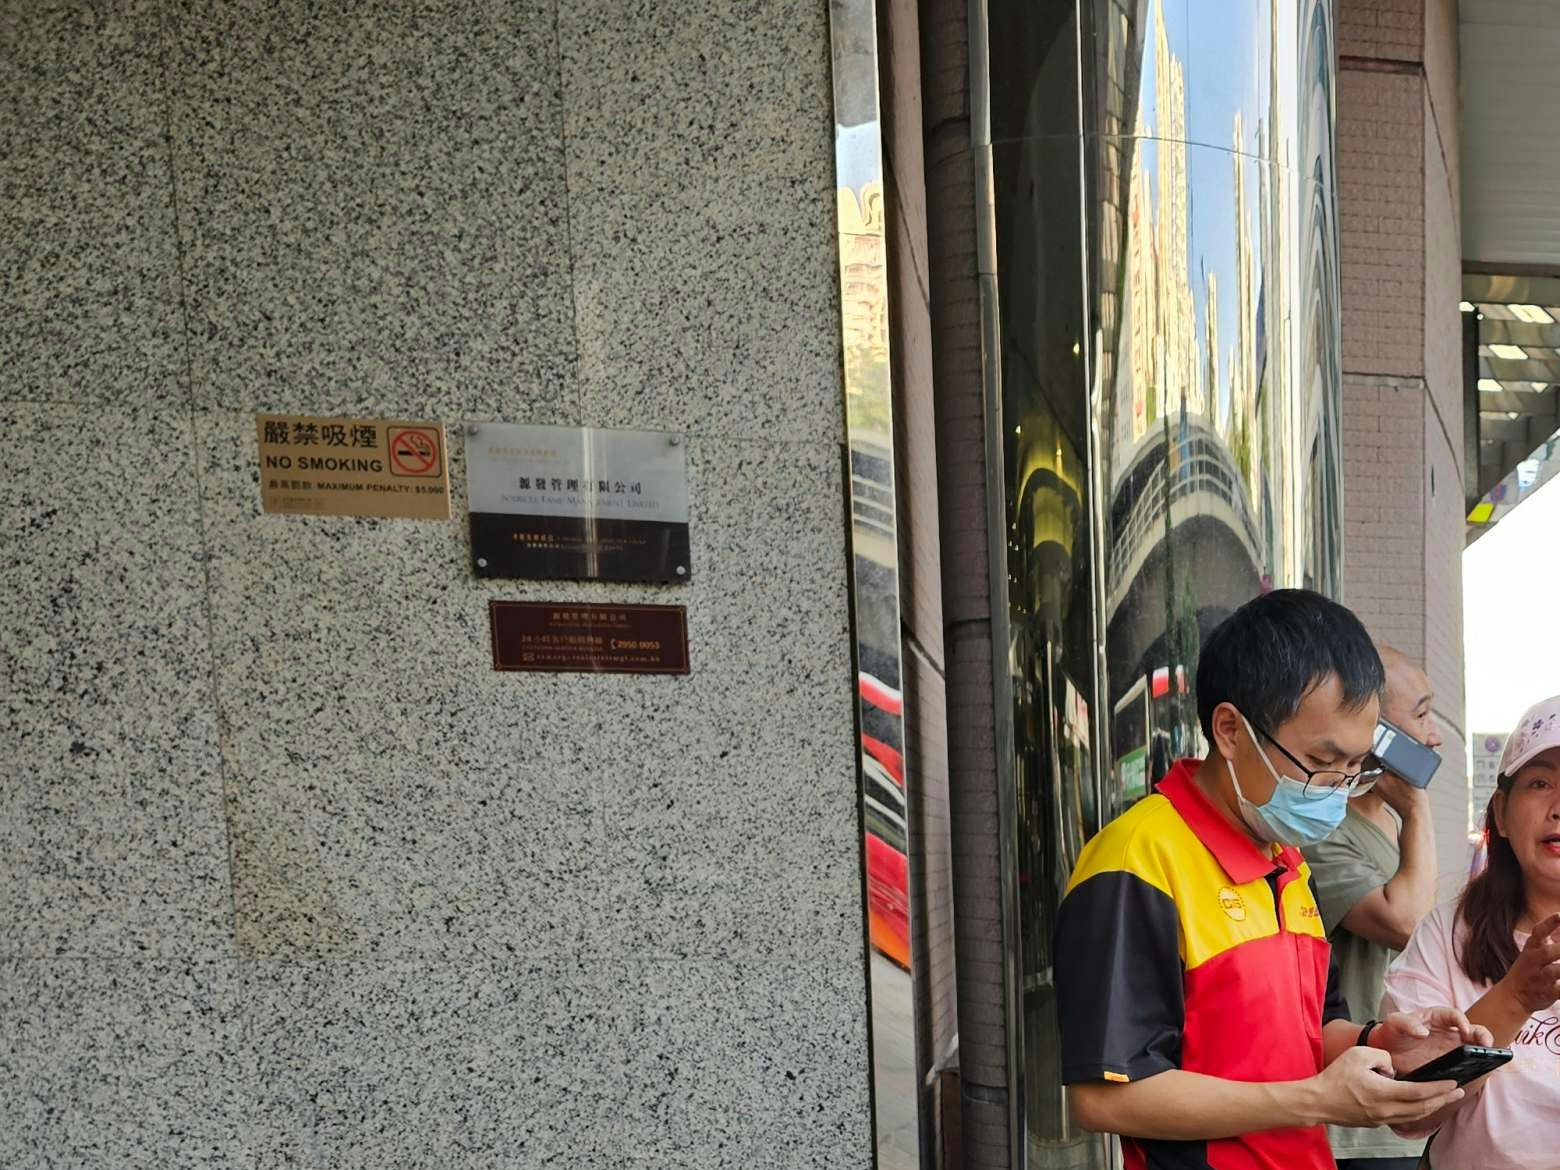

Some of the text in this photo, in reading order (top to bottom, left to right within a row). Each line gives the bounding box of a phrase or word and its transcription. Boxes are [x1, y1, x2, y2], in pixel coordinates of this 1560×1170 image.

[264, 421, 378, 448] 嚴禁吸煙
[266, 456, 383, 472] NO SMOKING
[317, 482, 363, 491] MAXIMUM
[519, 476, 642, 495] 源發管理限公司
